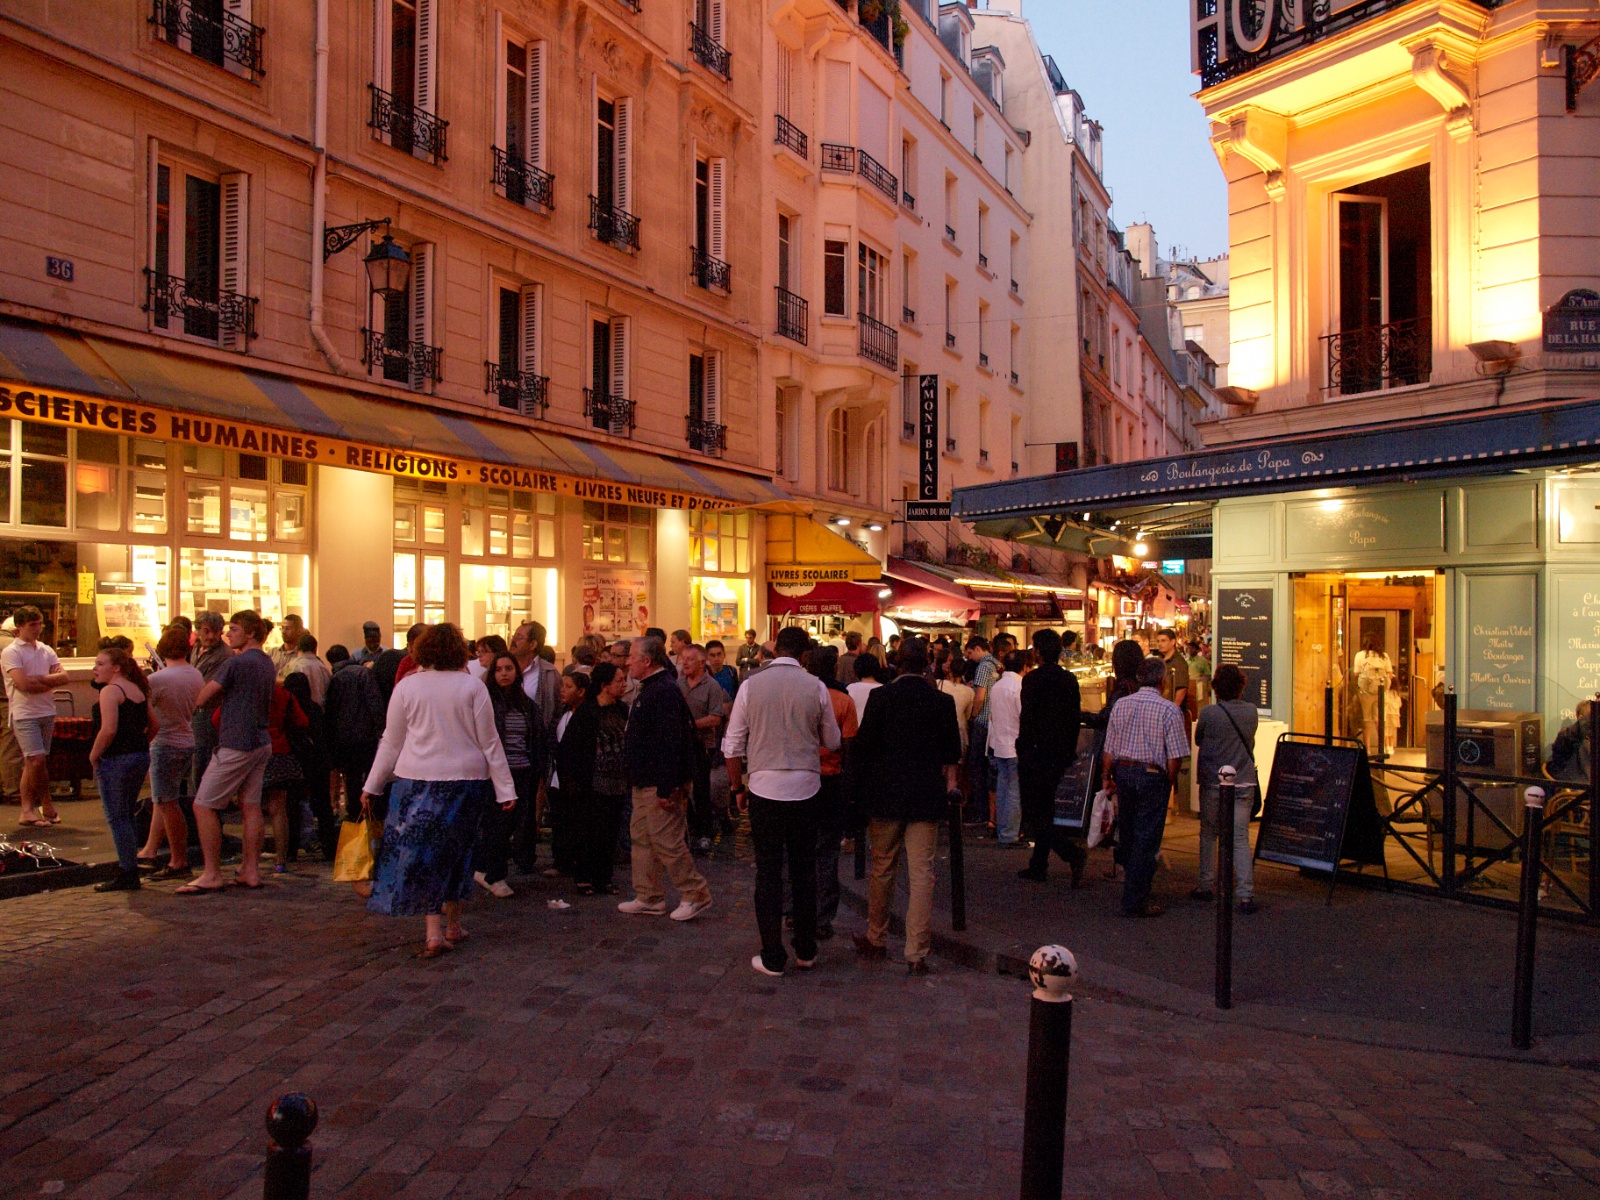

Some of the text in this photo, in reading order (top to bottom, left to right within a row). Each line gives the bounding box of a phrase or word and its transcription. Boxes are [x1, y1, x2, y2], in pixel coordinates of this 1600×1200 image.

[51, 257, 71, 279] 36
[1570, 321, 1596, 331] RUE
[1548, 334, 1563, 344] DE
[1564, 334, 1579, 344] LA
[0, 386, 157, 434] SCIENCES
[171, 416, 318, 459] HUMAINES
[346, 445, 458, 479] RELIGIONS
[479, 466, 557, 491] SCOLAIRE
[574, 480, 622, 501] LIVRES
[627, 488, 667, 507] NEUFS
[671, 495, 684, 509] ET
[924, 389, 934, 496] MONT BLANC
[1166, 450, 1291, 483] Boulangerie de Papa
[908, 507, 950, 516] JARDIN DU ROI
[1349, 530, 1376, 548] Papa
[771, 570, 849, 580] LIVRES SCOLAIRES
[799, 603, 842, 612] CRÊPES GAUFRES
[1483, 648, 1524, 664] Boulanger
[1576, 678, 1599, 689] Lait
[1487, 696, 1514, 708] France
